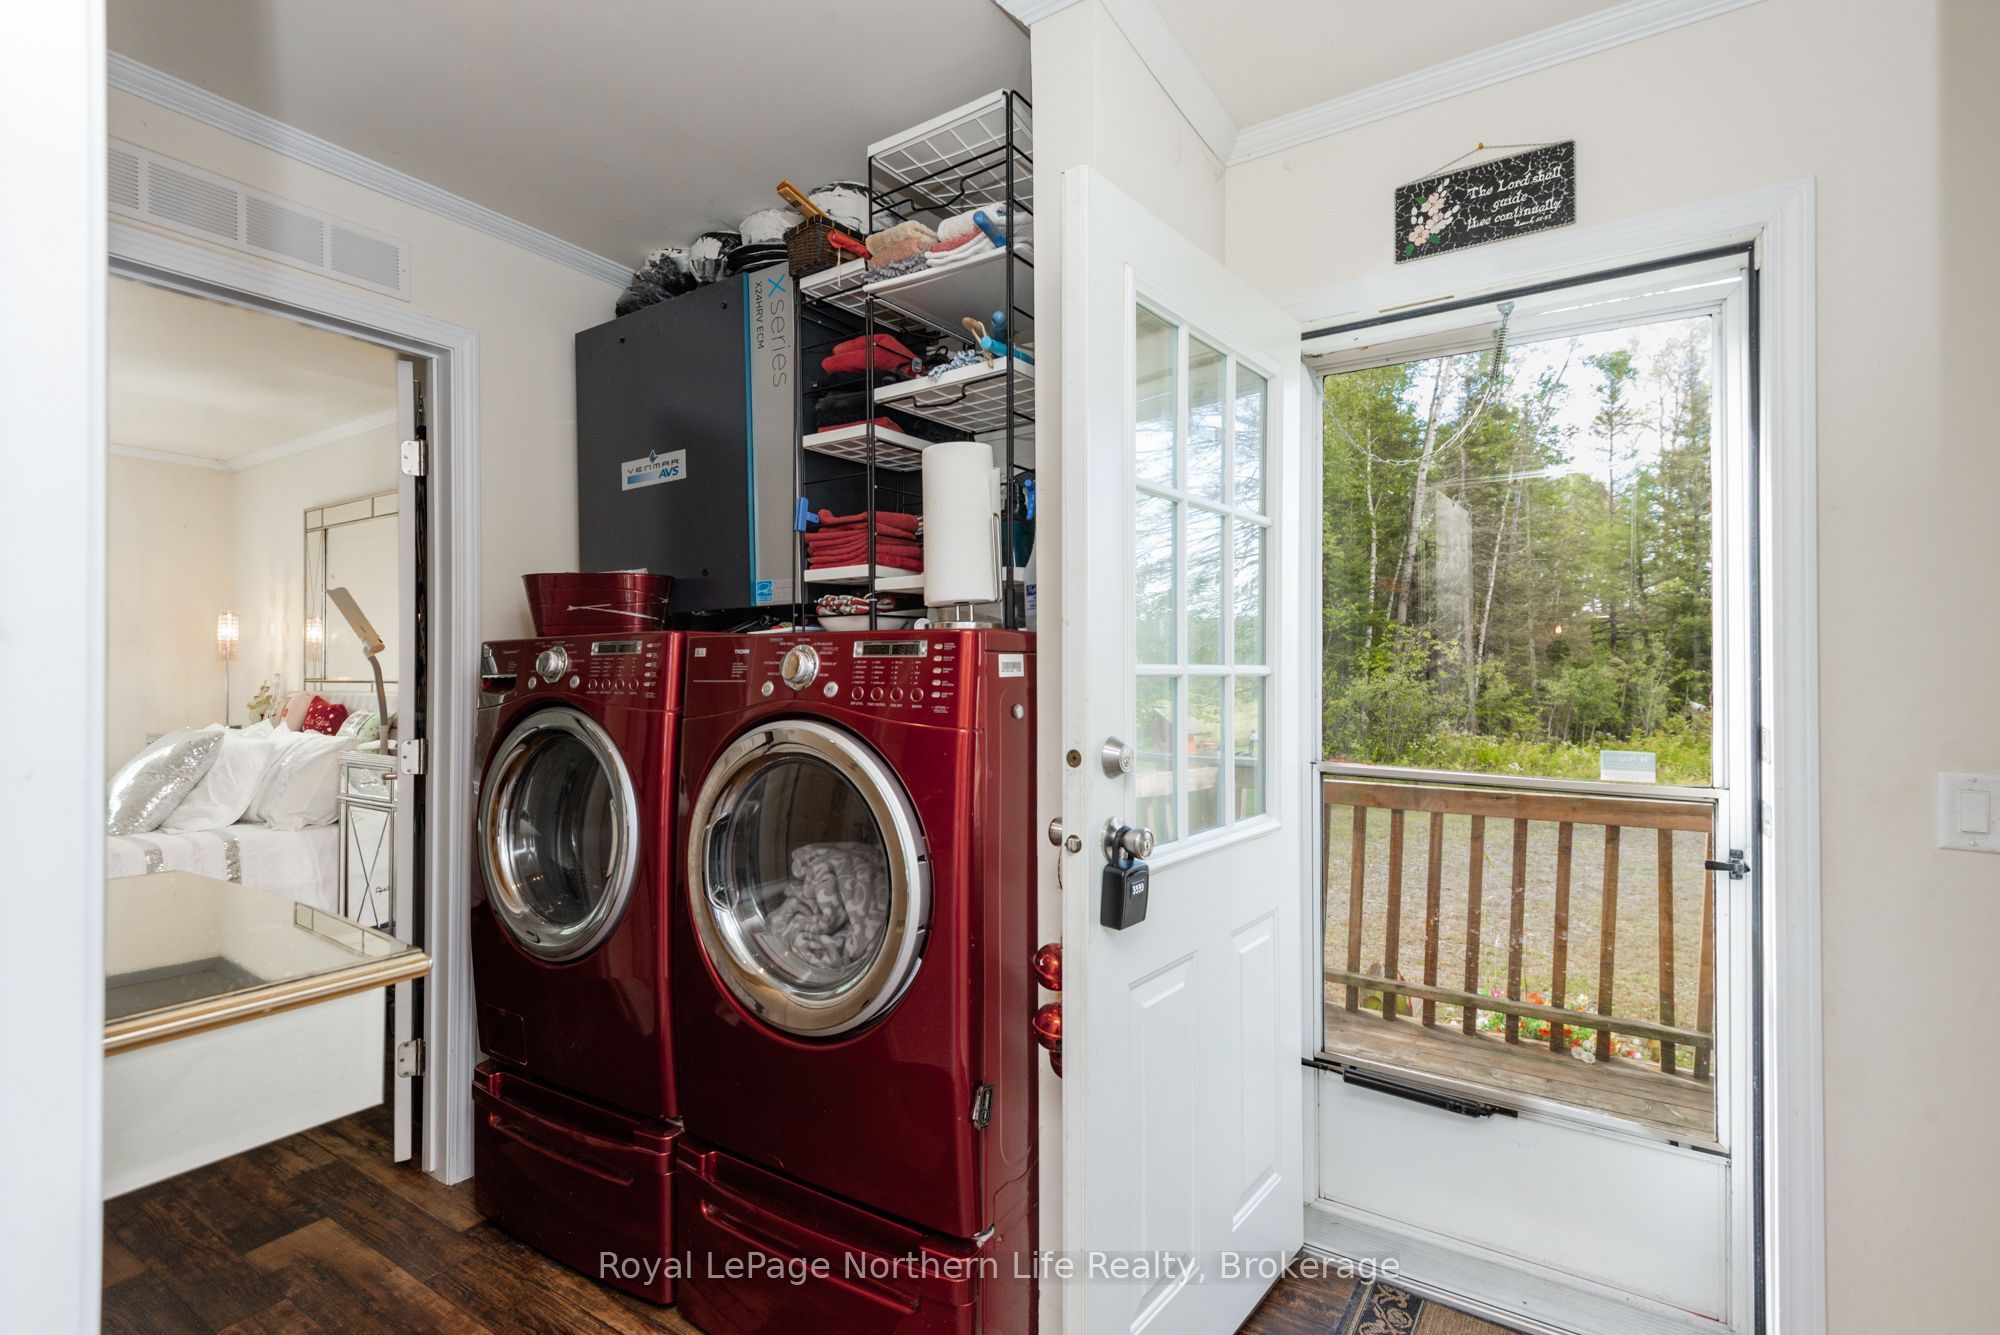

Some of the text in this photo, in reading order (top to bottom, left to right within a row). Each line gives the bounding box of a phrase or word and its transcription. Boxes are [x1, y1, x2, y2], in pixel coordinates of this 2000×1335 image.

[1466, 165, 1562, 199] The Lord shall
[1491, 189, 1528, 212] guide
[1466, 216, 1491, 230] thee
[755, 281, 764, 349] X24HRV ECM
[770, 299, 790, 387] series
[658, 466, 679, 479] AVS
